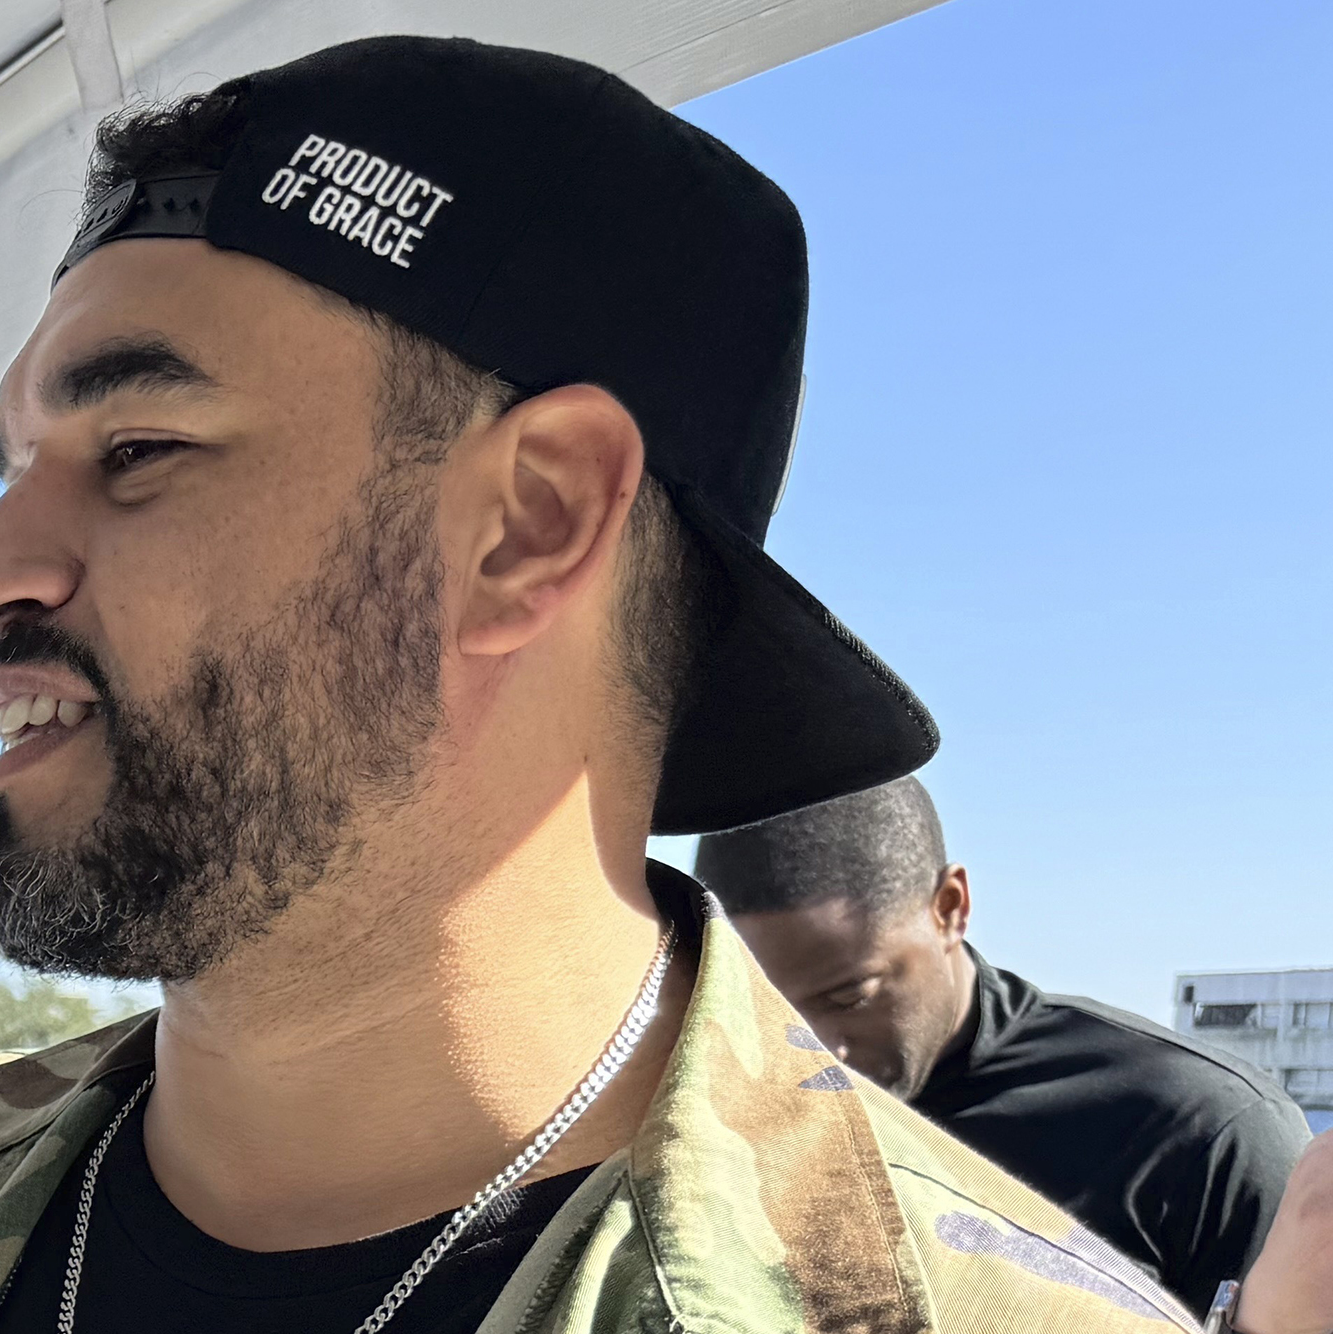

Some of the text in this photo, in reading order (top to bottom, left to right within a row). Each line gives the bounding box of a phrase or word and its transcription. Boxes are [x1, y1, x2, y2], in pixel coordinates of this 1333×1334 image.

[261, 168, 425, 269] OF GRACE
[288, 134, 454, 228] PRODUCT
